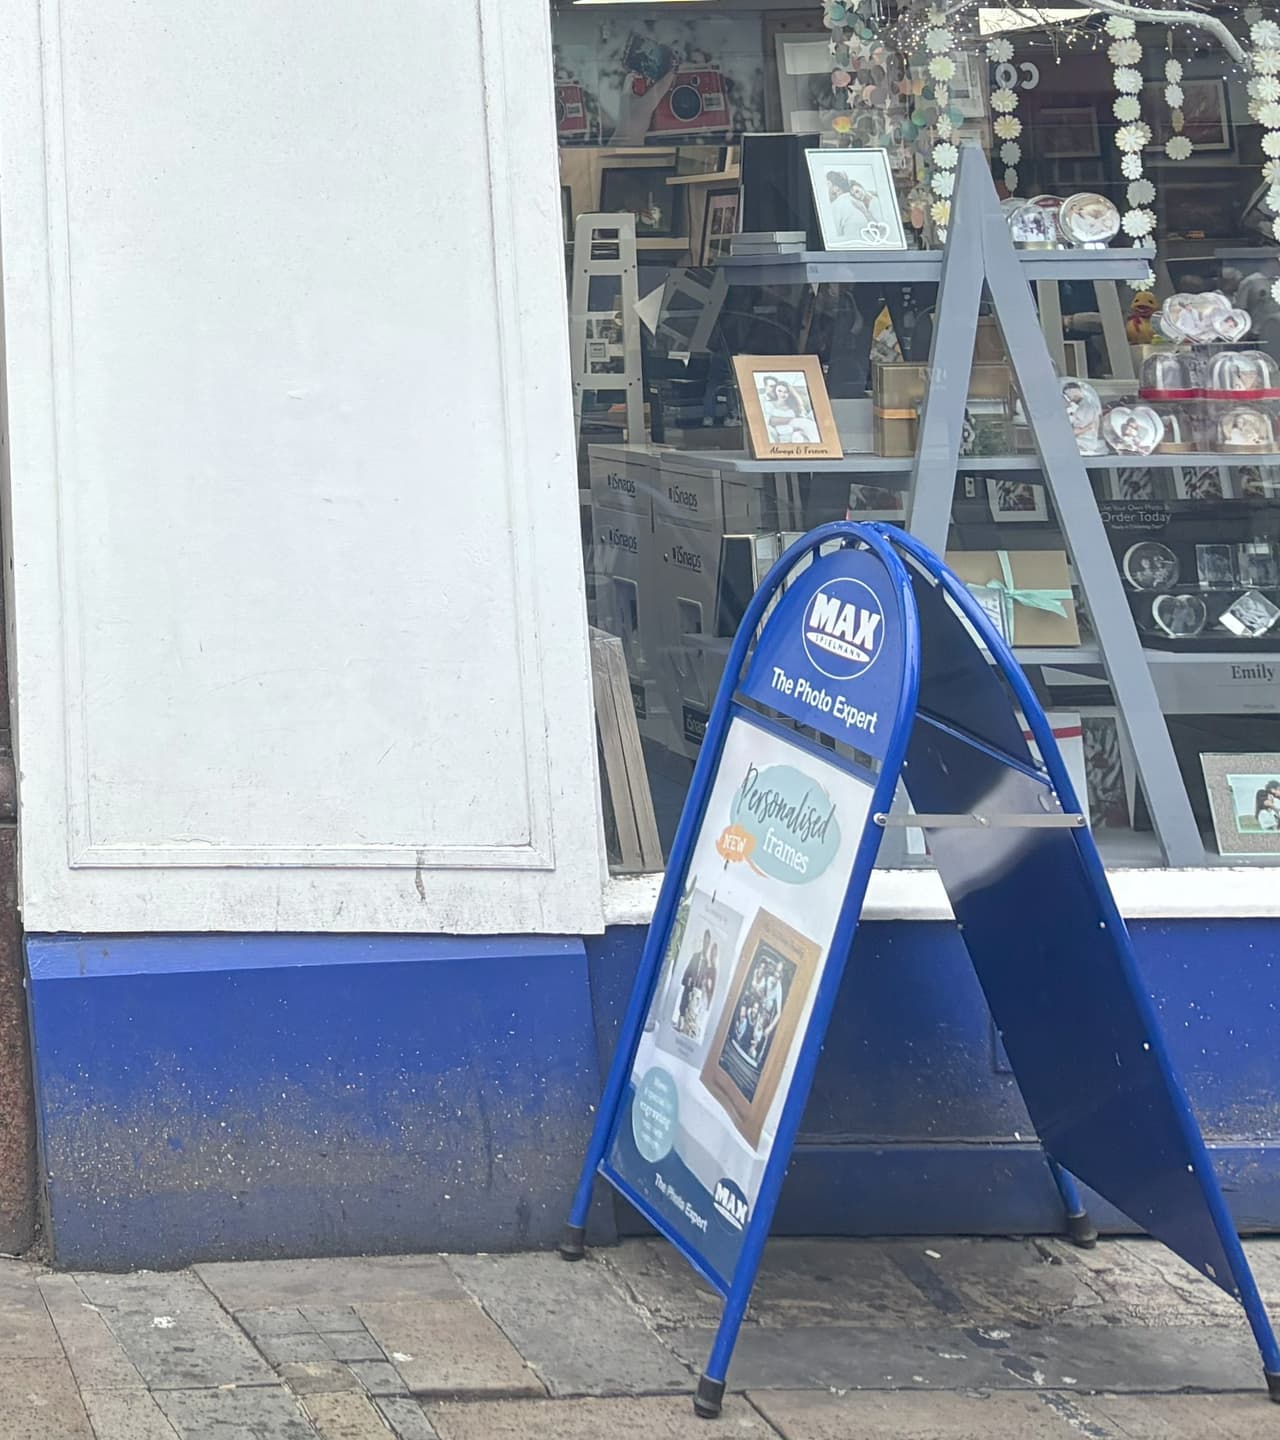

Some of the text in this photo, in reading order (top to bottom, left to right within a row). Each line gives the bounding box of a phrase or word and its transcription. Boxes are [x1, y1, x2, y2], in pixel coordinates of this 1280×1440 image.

[1137, 511, 1172, 524] Today
[809, 592, 881, 651] MAX
[815, 634, 861, 659] SPIELMANN
[1231, 663, 1274, 682] Emily
[771, 666, 879, 734] The Photo Expert
[736, 762, 837, 845] Personalised
[722, 833, 747, 853] NEW
[762, 826, 810, 875] frames
[714, 1182, 749, 1226] MAX
